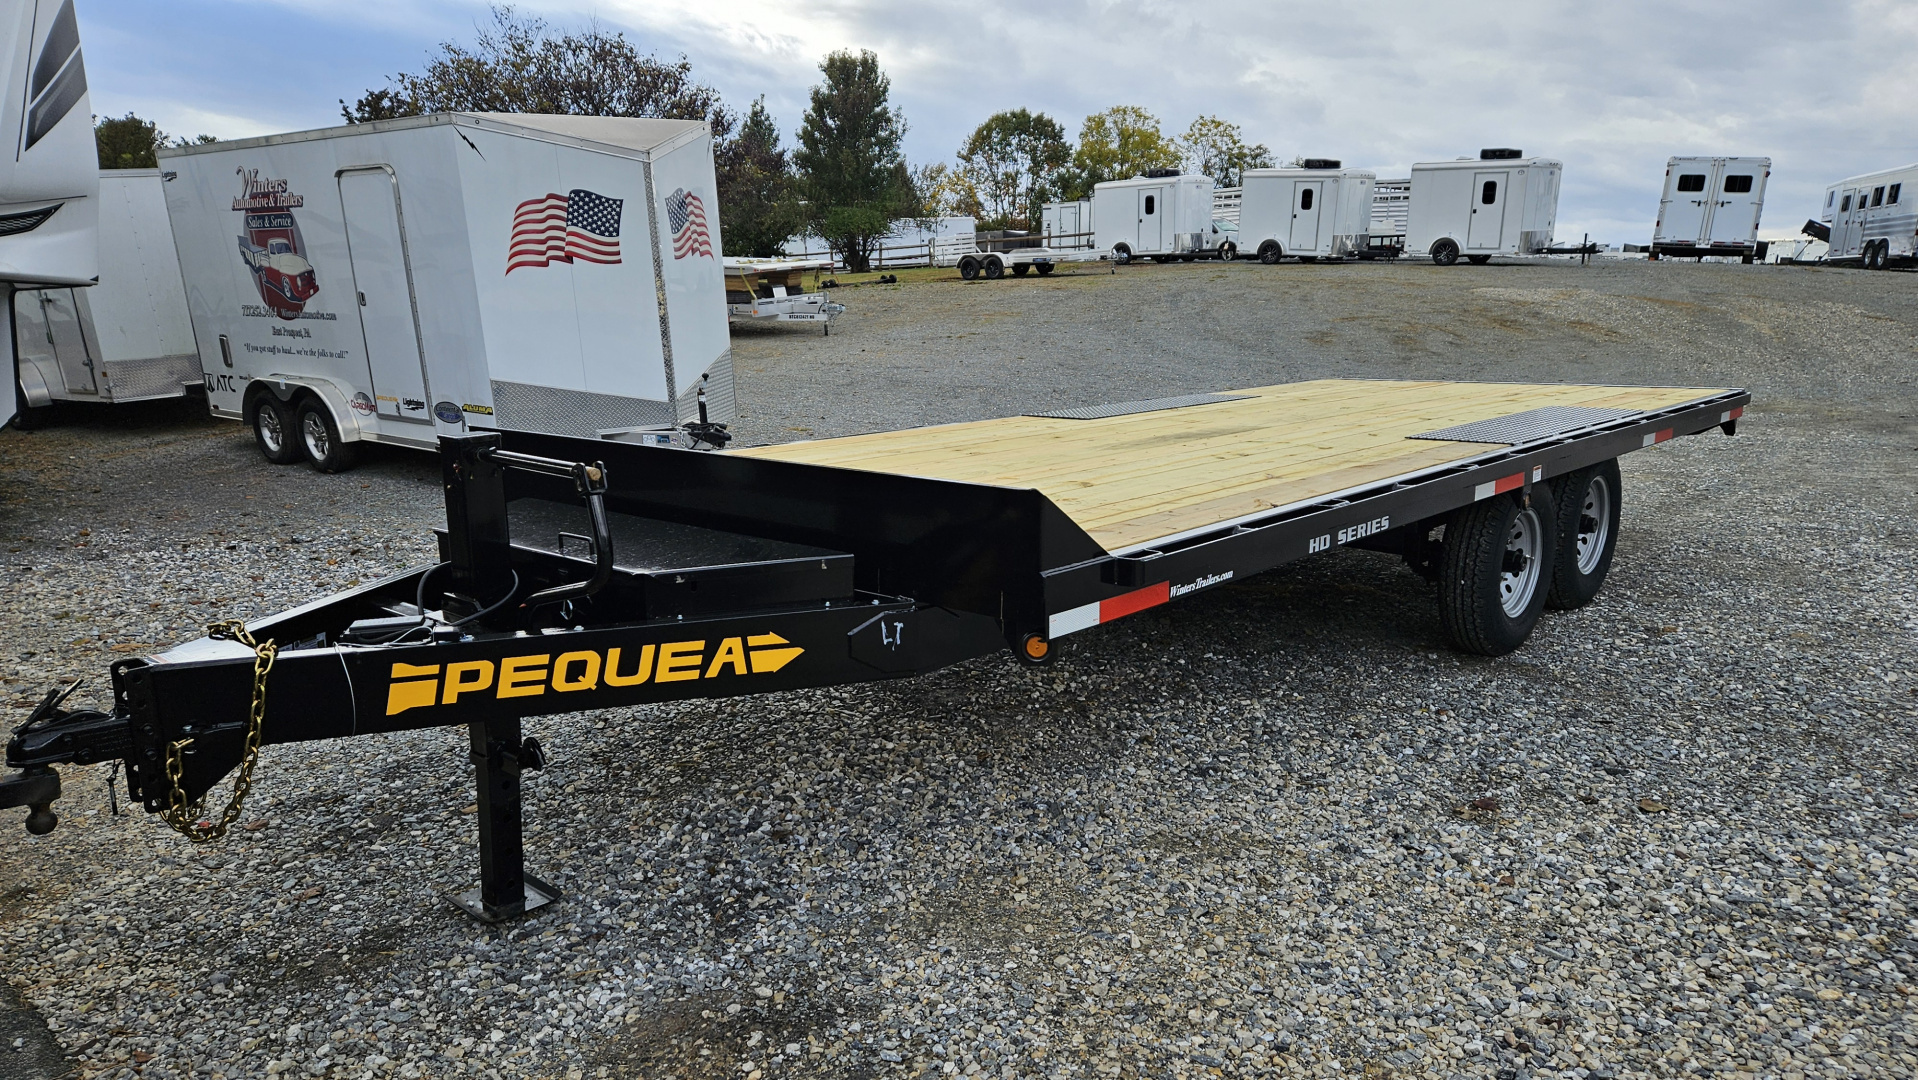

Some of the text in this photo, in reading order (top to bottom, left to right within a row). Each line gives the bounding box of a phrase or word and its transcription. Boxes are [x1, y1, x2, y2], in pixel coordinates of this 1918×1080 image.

[236, 165, 287, 199] Winters
[231, 192, 303, 211] Automotive & Trailers
[248, 215, 292, 228] Sales & Service
[267, 345, 276, 355] stuff
[317, 349, 328, 359] folks
[217, 374, 236, 393] ATC
[462, 403, 493, 415] ALUMA
[1309, 515, 1390, 554] HD SERIES
[1169, 569, 1234, 598] WintersTrailers.com
[441, 636, 748, 704] PEQUEA
